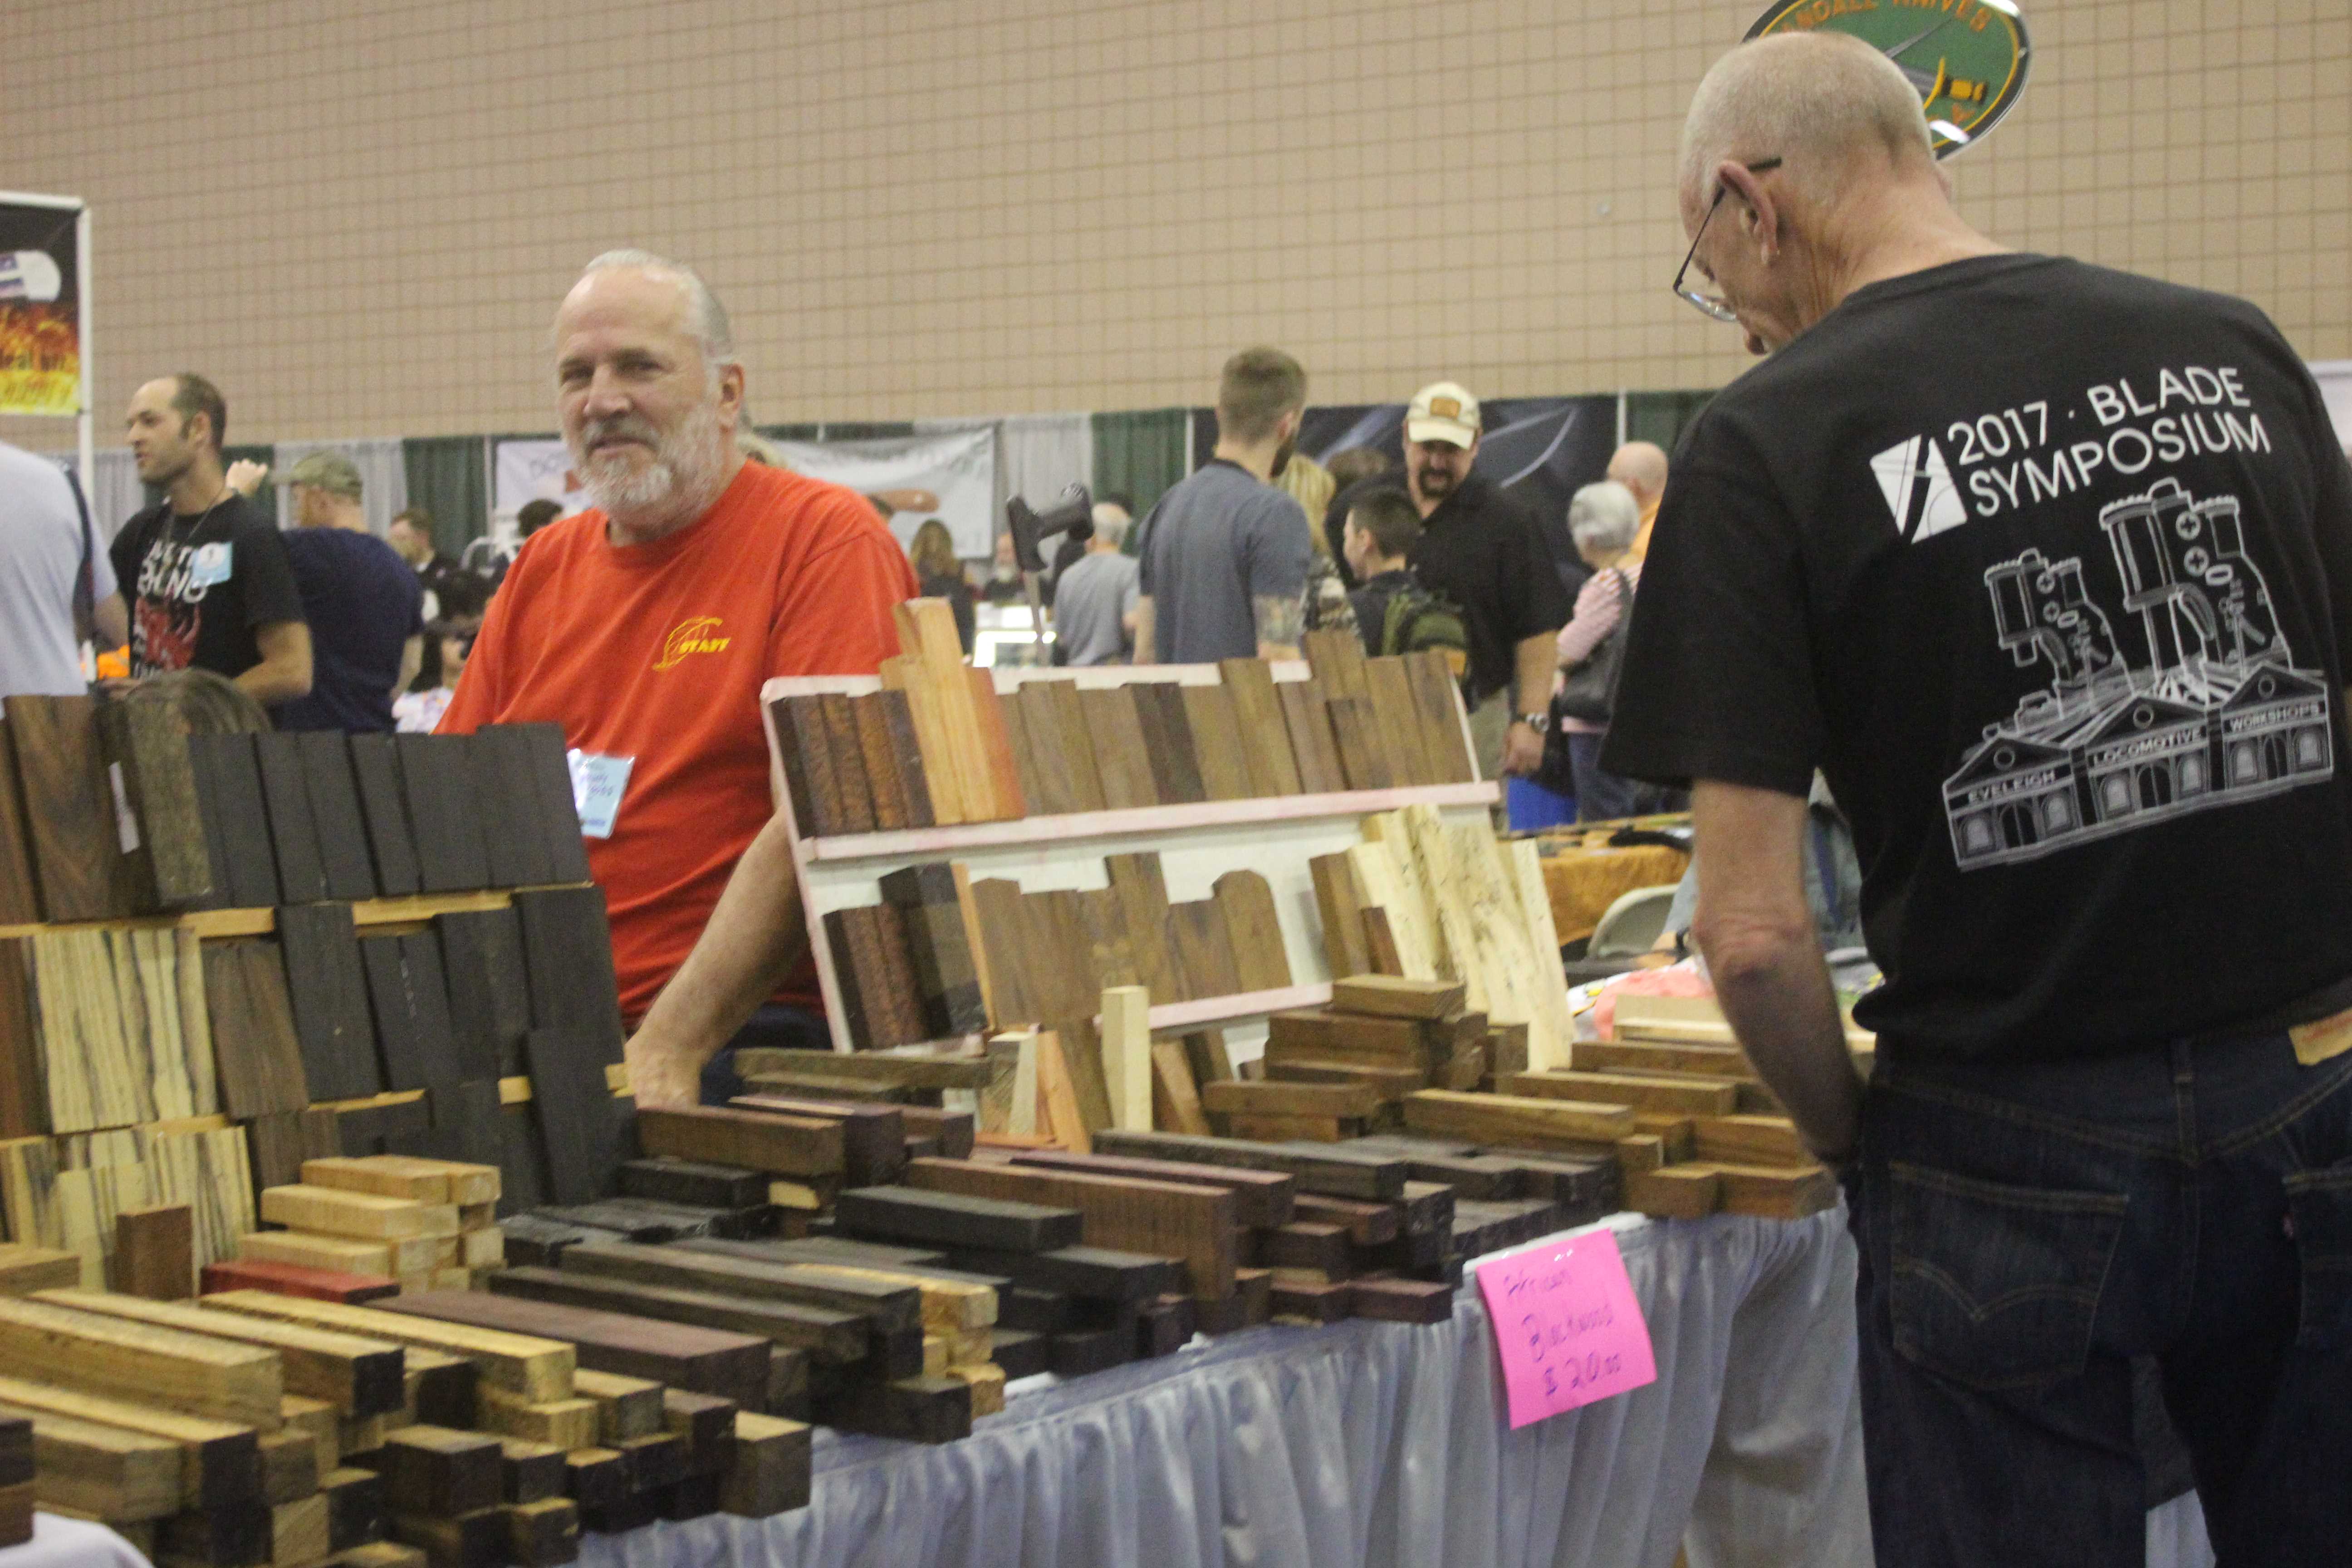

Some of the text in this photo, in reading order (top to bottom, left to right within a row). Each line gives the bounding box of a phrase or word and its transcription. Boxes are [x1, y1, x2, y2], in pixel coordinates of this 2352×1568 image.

[1947, 400, 2048, 466] 2017
[2087, 366, 2251, 426] BLADE
[1969, 410, 2271, 518] SYMPOSIUM
[1967, 703, 2320, 803] EVELEIGH LOCOMOTIVE WORKSHOPS
